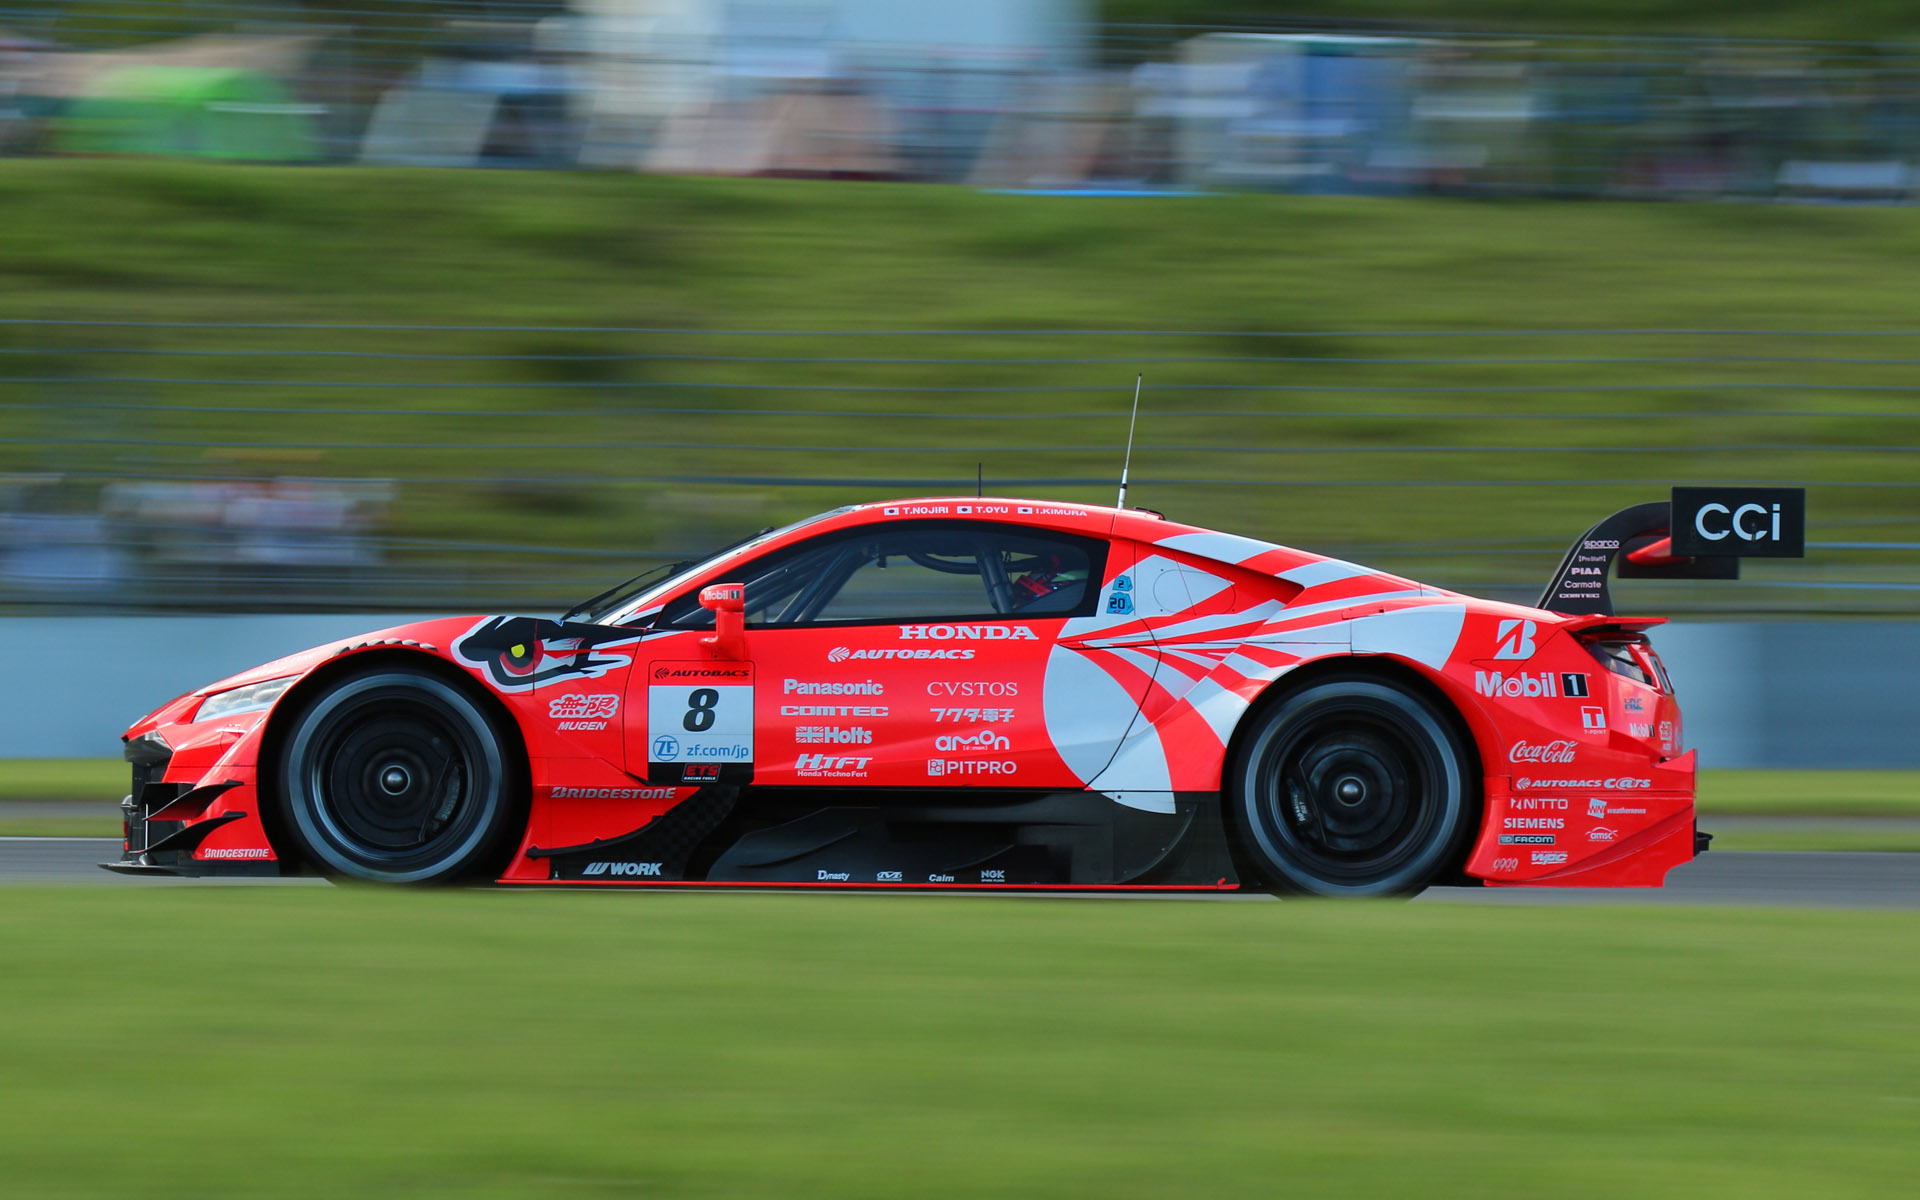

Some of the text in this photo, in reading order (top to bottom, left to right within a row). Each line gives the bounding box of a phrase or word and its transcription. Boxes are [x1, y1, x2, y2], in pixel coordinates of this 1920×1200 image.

[903, 506, 949, 515] T.NOJIRI
[976, 506, 1008, 514] T.OYU
[1035, 508, 1088, 517] I.KIMURA
[1584, 540, 1619, 549] sparco
[1571, 567, 1602, 575] PIAA
[1118, 579, 1124, 588] 2
[704, 589, 728, 600] Mobil
[1109, 598, 1125, 609] 20
[899, 625, 1039, 640] HONDA
[849, 649, 976, 660] AUTOBACS
[671, 669, 750, 677] AUTOBACS
[783, 678, 883, 695] Panasonic
[927, 681, 1018, 696] CVSTOS
[1475, 671, 1557, 697] Mobil
[549, 693, 620, 719] 無限
[682, 688, 719, 732] 8
[781, 705, 889, 716] COMTEC
[557, 721, 607, 731] MUGEN
[825, 727, 872, 744] Holts
[654, 739, 678, 758] ZF
[687, 743, 749, 759] zf.com/jp
[1509, 740, 1578, 763] Coca-Cola
[794, 753, 873, 770] HTFT
[947, 761, 1017, 774] PITPRO
[686, 764, 719, 776] ETS
[1531, 779, 1602, 788] AUTOBACS
[551, 786, 677, 799] BRIDGESTONE
[1523, 798, 1569, 810] NITTO
[1607, 807, 1647, 815] weathernews
[1504, 817, 1565, 829] SIEMENS
[204, 848, 269, 858] BRIDGESTONE
[610, 862, 663, 876] WORK
[981, 870, 1005, 879] NGK
[817, 870, 850, 882] Dynasty
